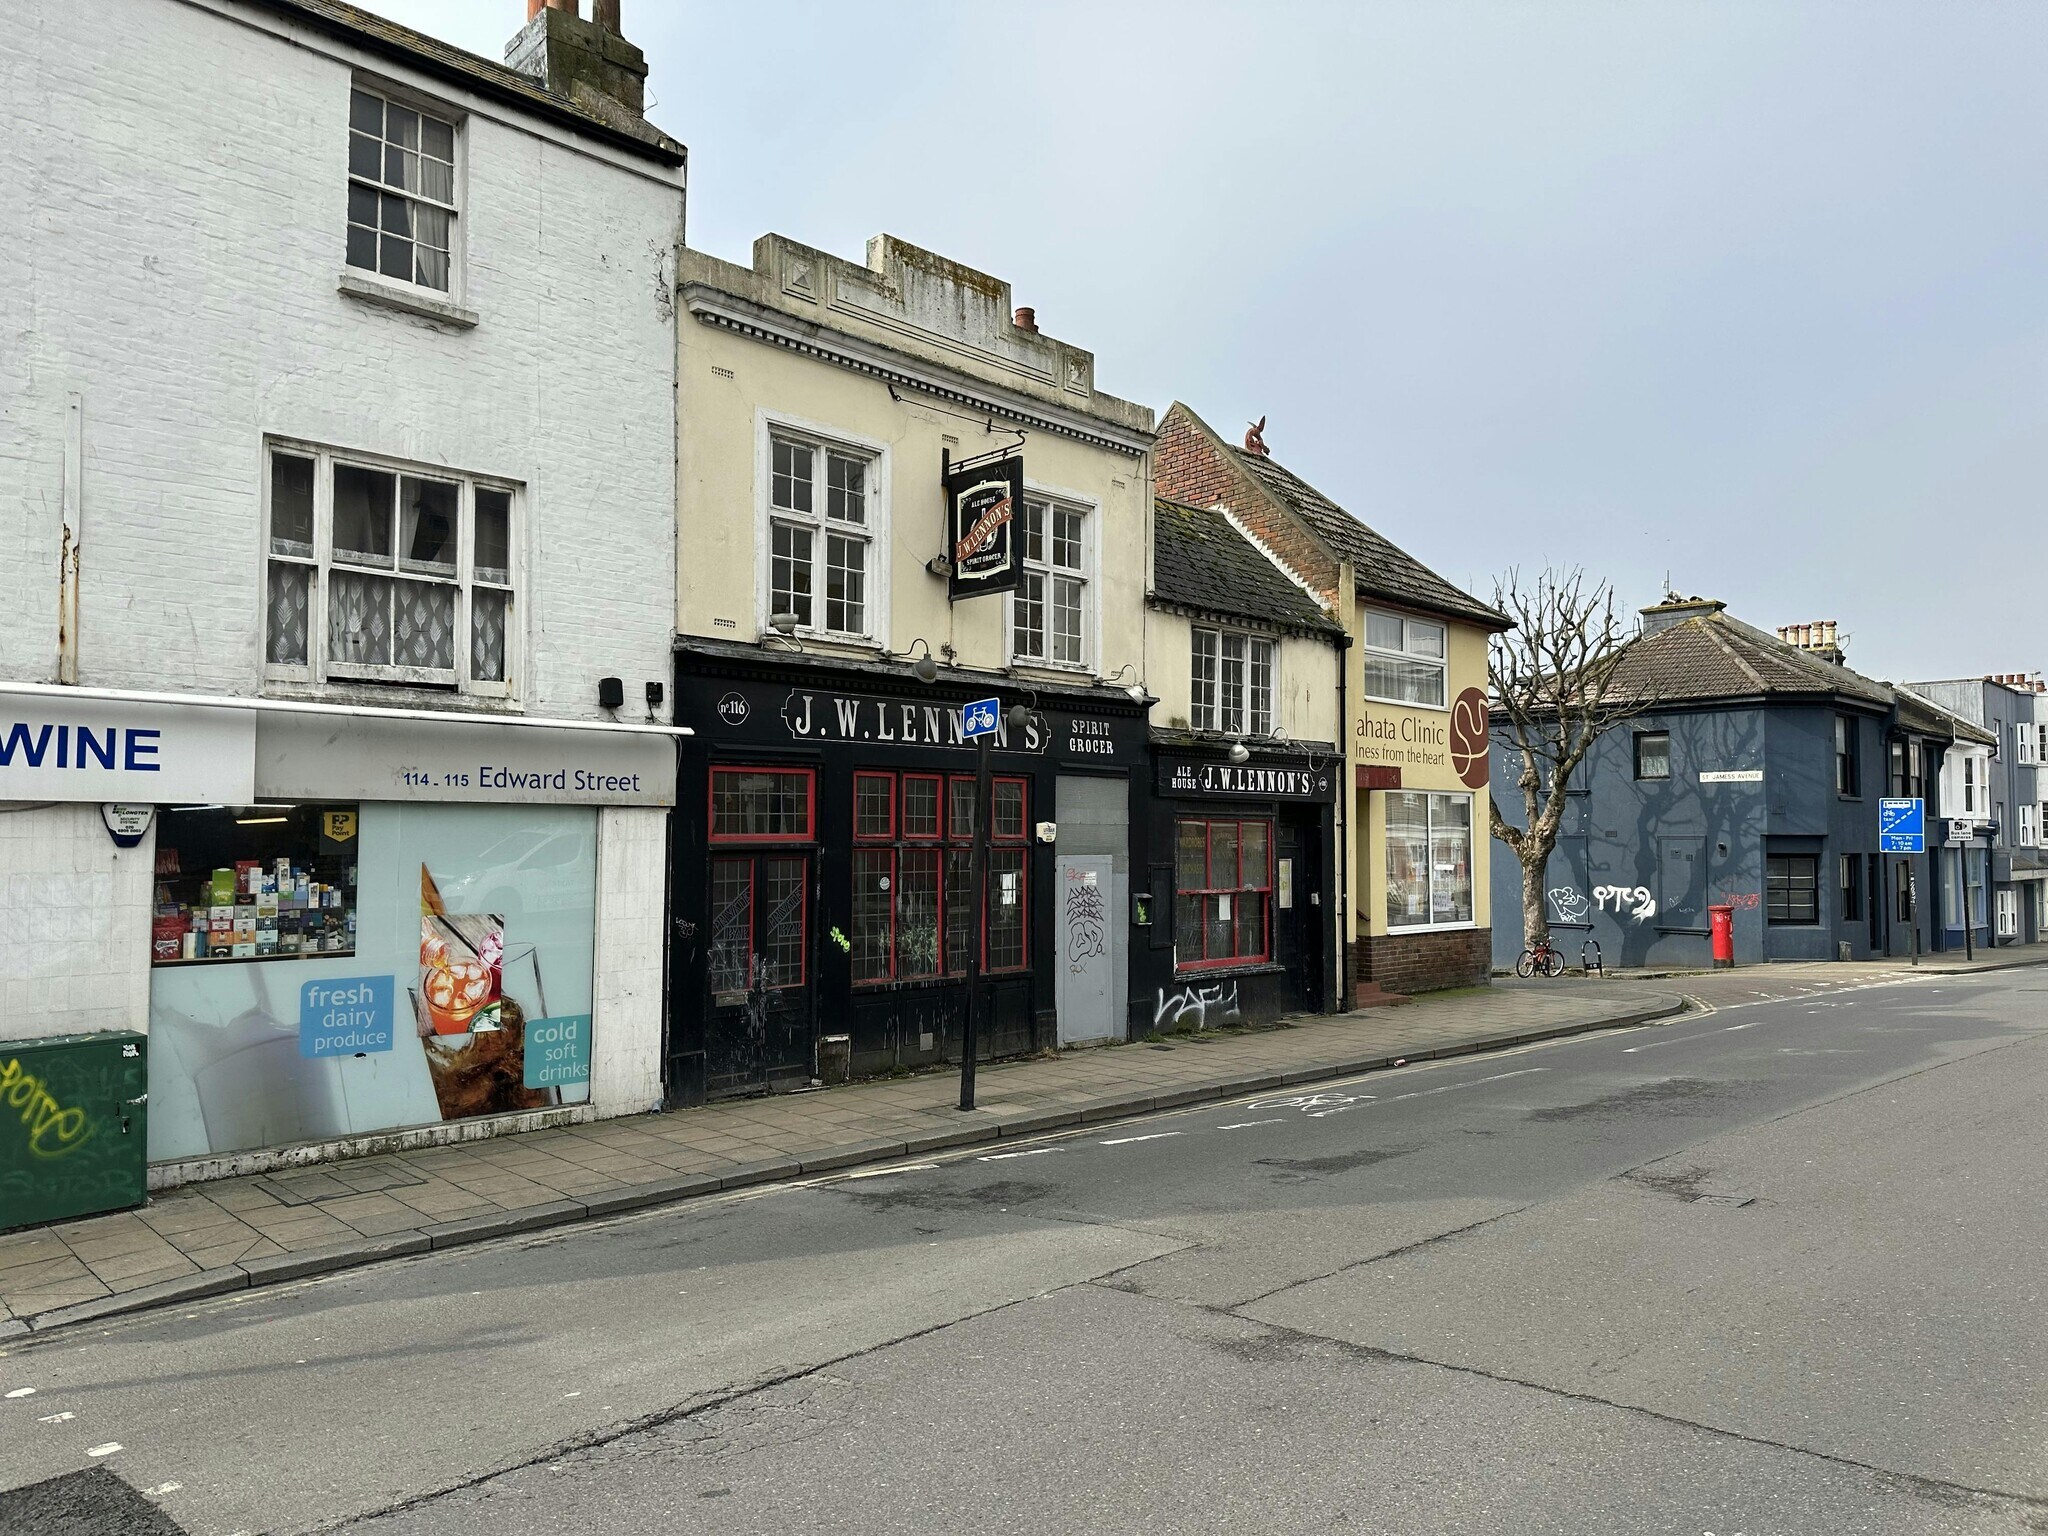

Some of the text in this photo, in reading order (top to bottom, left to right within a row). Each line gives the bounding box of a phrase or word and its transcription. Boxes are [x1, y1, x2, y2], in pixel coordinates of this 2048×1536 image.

[796, 695, 1040, 750] J.W.LENNNS
[1071, 719, 1110, 736] SPIRIT
[1356, 710, 1445, 746] ahata Clinic
[0, 722, 161, 772] WINE
[1069, 737, 1114, 754] GROCER
[1382, 743, 1405, 762] from
[1407, 746, 1424, 763] the
[1423, 747, 1445, 766] heart
[403, 772, 430, 786] 114
[444, 773, 469, 787] 115
[479, 766, 567, 790] Edward
[574, 769, 640, 792] Street
[1176, 765, 1192, 777] ALE
[1171, 777, 1197, 789] HOUSE
[307, 983, 374, 1008] fresh
[322, 1008, 376, 1029] dairy
[314, 1031, 387, 1054] produce
[533, 1020, 577, 1043] cold
[545, 1042, 577, 1061] soft
[539, 1061, 589, 1082] drinks
